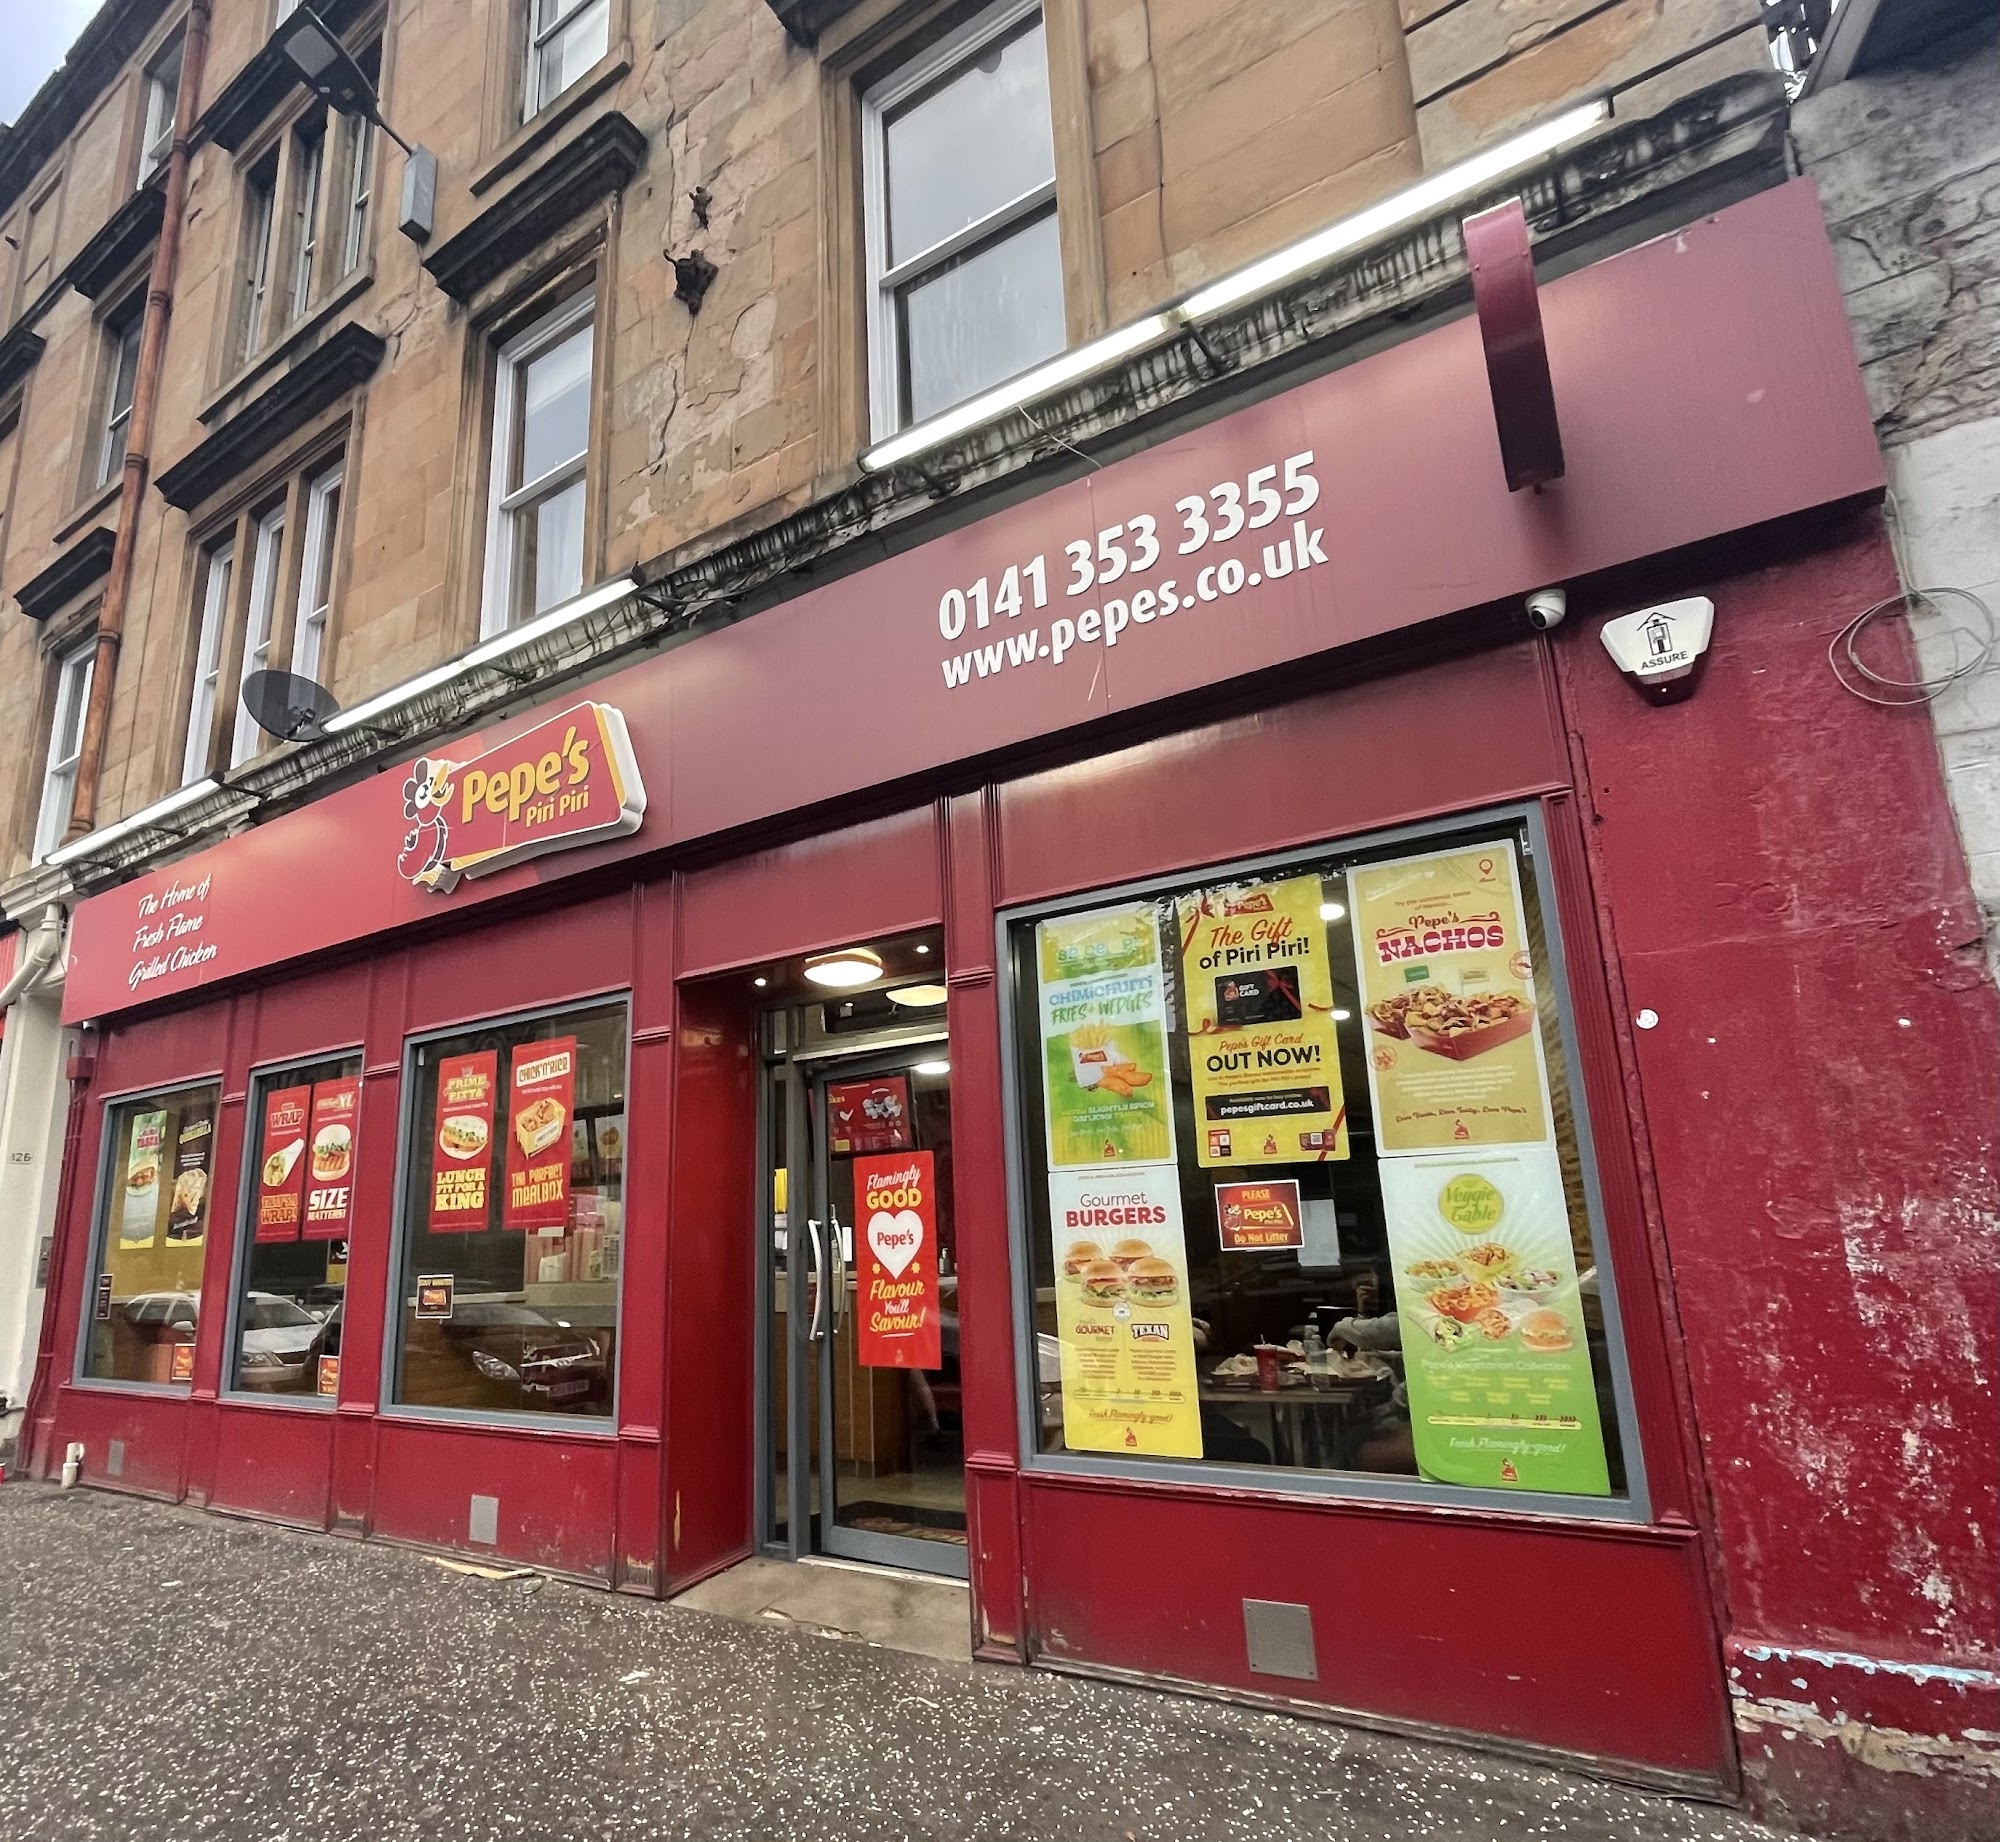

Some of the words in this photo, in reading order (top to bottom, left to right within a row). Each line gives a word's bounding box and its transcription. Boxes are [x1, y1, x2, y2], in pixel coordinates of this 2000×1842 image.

[939, 554, 1048, 640] 0141
[1064, 513, 1160, 596] 353
[1175, 450, 1320, 555] 3355
[941, 520, 1329, 689] www.pepes.co.uk
[1641, 650, 1689, 670] ASSURE
[462, 726, 590, 824] Pepe's
[525, 800, 555, 828] Piri
[559, 785, 589, 817] Piri
[139, 893, 159, 919] The
[160, 880, 196, 910] Home
[196, 872, 213, 902] of
[1408, 910, 1460, 930] Pepe's
[132, 922, 165, 952] Fresh
[165, 913, 204, 941] Flame
[1211, 925, 1245, 949] The
[1251, 916, 1294, 946] Gift
[1199, 951, 1222, 970] of
[1226, 946, 1261, 966] Piri
[1267, 937, 1310, 960] Piri!
[1377, 925, 1505, 963] NACHOS
[128, 953, 172, 991] Grilled
[171, 941, 218, 972] Chicken
[1051, 1003, 1087, 1026] FRIES
[1098, 990, 1153, 1016] WEDGES
[1206, 1051, 1252, 1073] OUT
[1257, 1045, 1321, 1068] NOW!
[448, 1075, 488, 1090] PRIME
[448, 1088, 485, 1102] PITTA
[1220, 1099, 1315, 1116] pepesgiftcard.co.uk
[271, 1110, 304, 1127] WRAP
[11, 1152, 32, 1162] 126
[437, 1168, 486, 1184] LUNCH
[866, 1164, 921, 1191] Flamingly
[437, 1184, 454, 1194] FIT
[455, 1182, 477, 1192] FOR
[512, 1178, 564, 1208] MEALBOX
[866, 1188, 922, 1209] GOOD
[1242, 1189, 1271, 1201] PLEASE
[1445, 1186, 1496, 1209] Veggie
[308, 1187, 350, 1211] SIZE
[434, 1192, 484, 1211] KING
[1080, 1191, 1148, 1208] Gourmet
[1066, 1206, 1166, 1227] BURGERS
[1243, 1206, 1283, 1222] Pepe's
[877, 1228, 914, 1249] Pepe's
[1234, 1233, 1247, 1244] Do
[1248, 1233, 1264, 1242] Not
[1265, 1232, 1289, 1242] Litter
[870, 1279, 925, 1300] Flavour
[869, 1306, 926, 1332] Savour!
[1076, 1325, 1115, 1335] GOURMET
[1131, 1323, 1169, 1341] TEXAN
